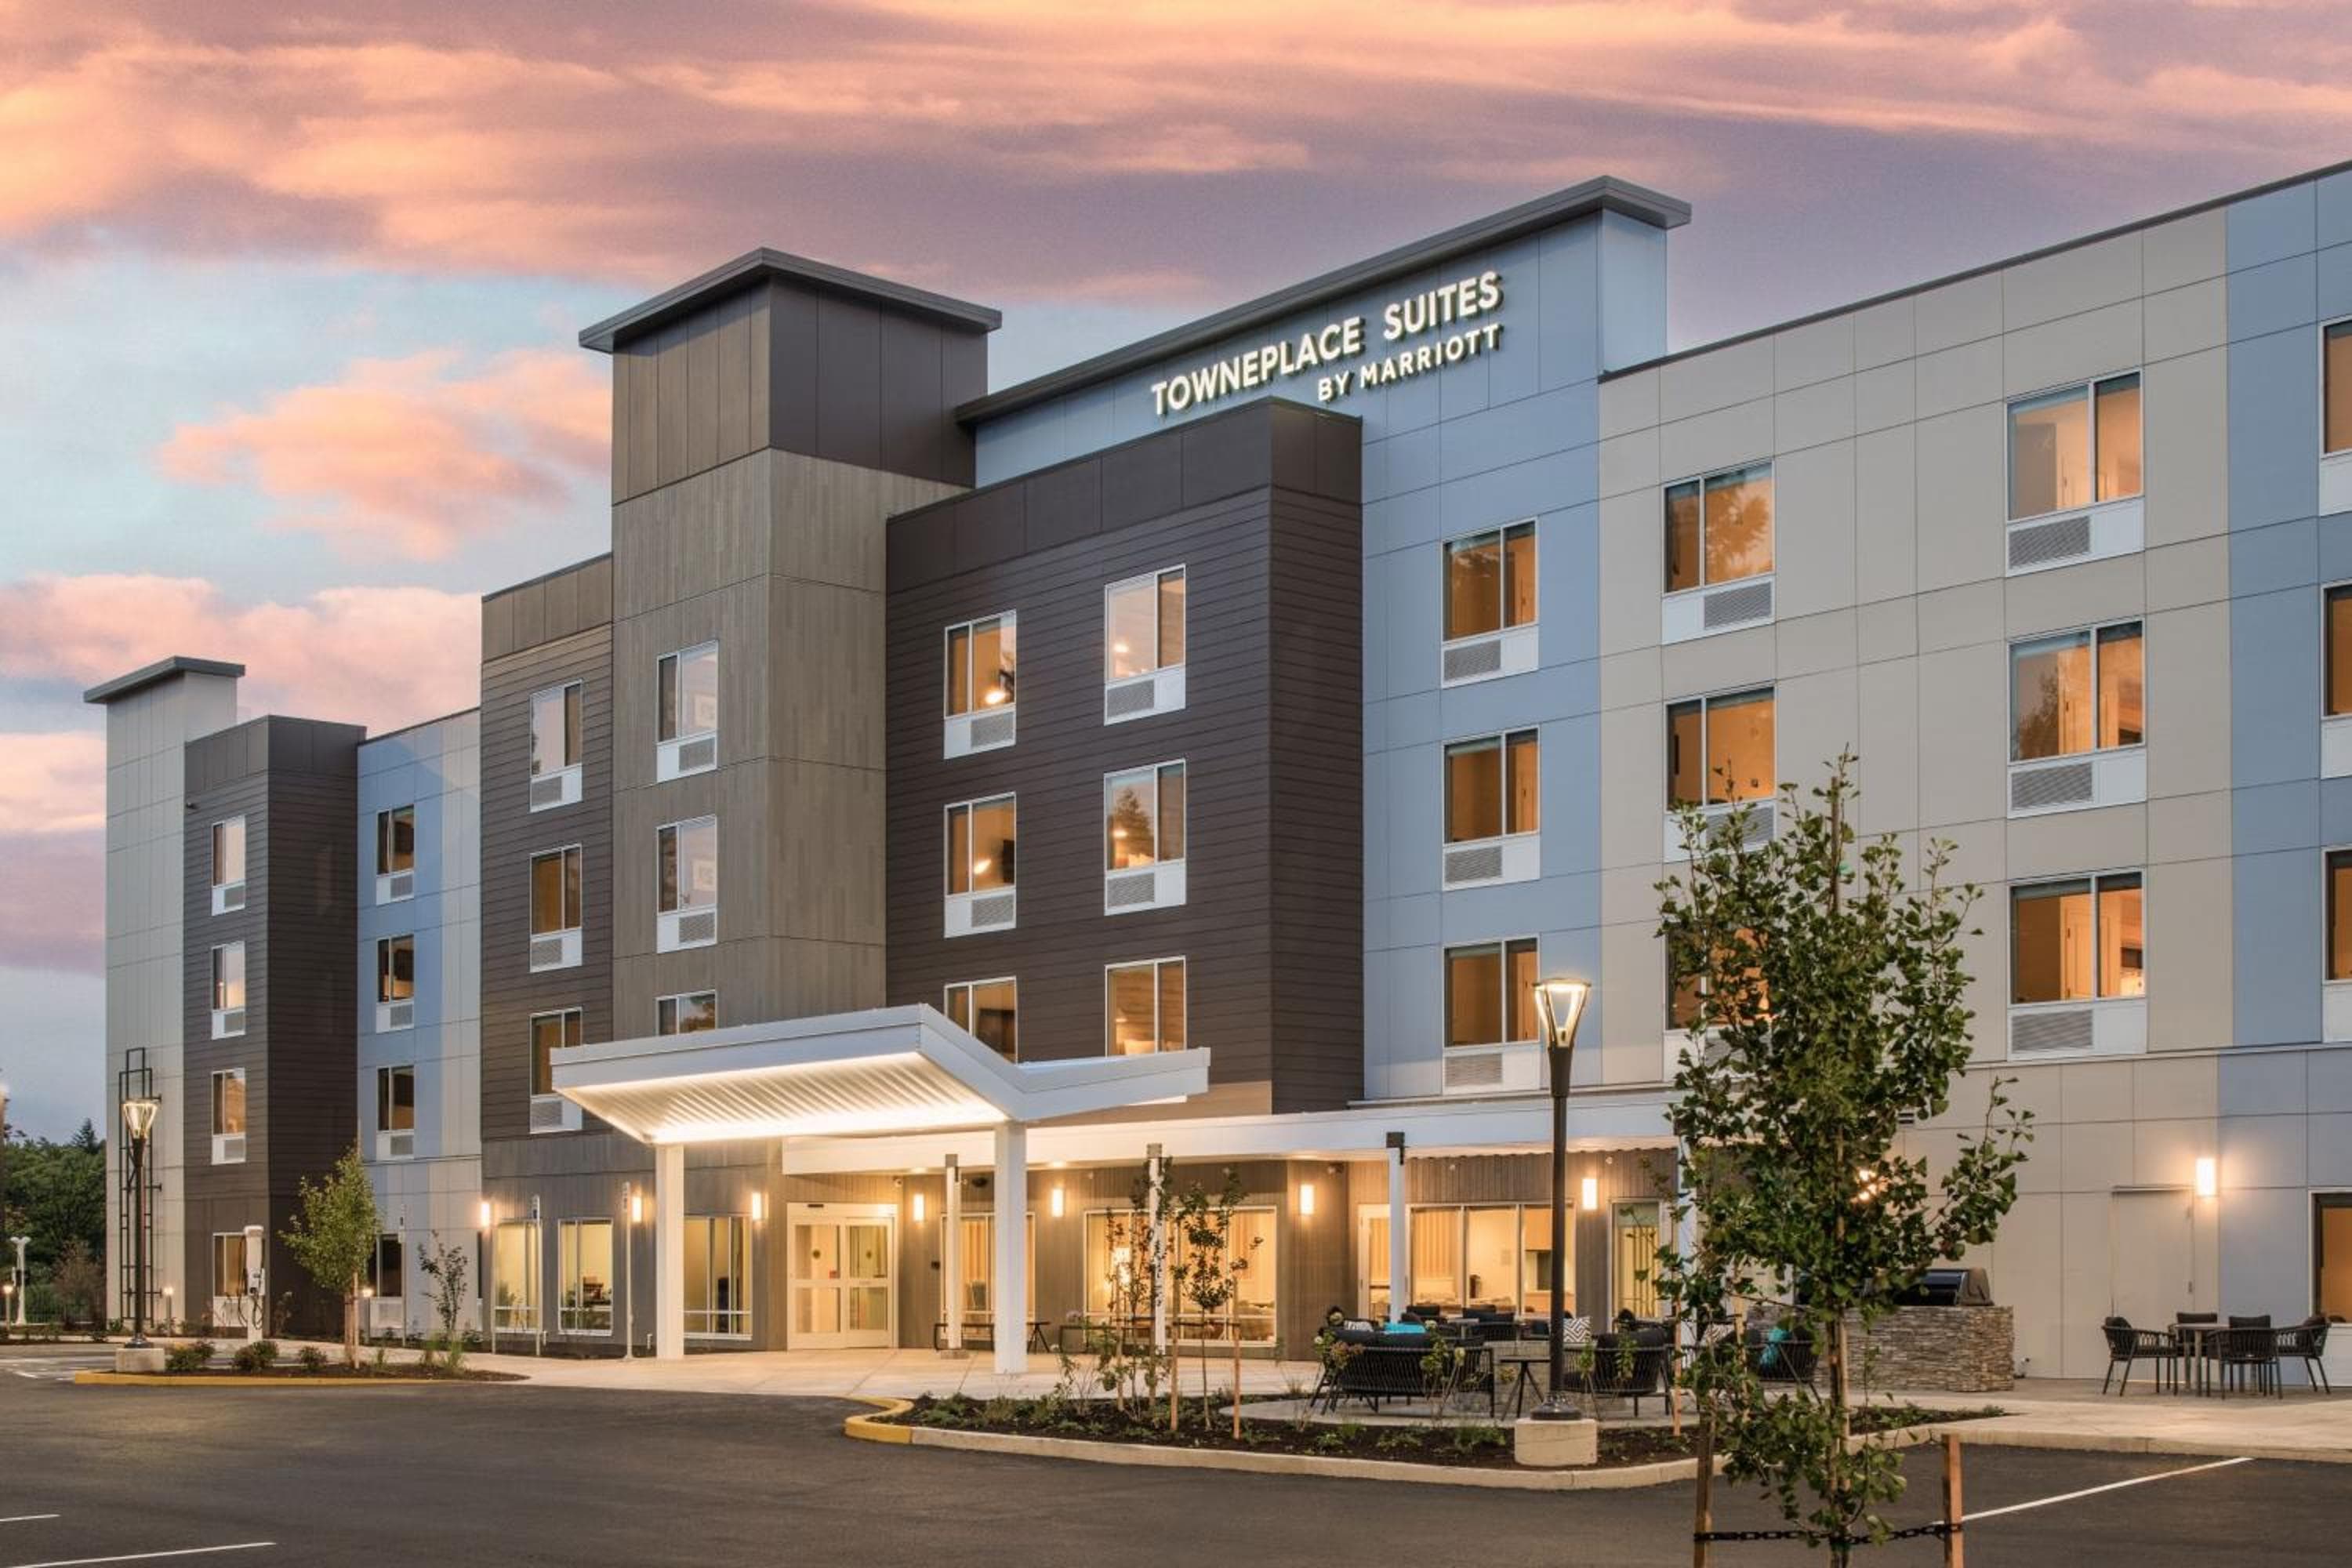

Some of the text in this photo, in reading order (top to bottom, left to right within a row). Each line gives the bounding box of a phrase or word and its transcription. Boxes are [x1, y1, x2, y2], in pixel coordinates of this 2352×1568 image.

[1151, 271, 1501, 416] TOWNEPLACE SUITES
[1317, 323, 1501, 402] BY MARRIOTT
